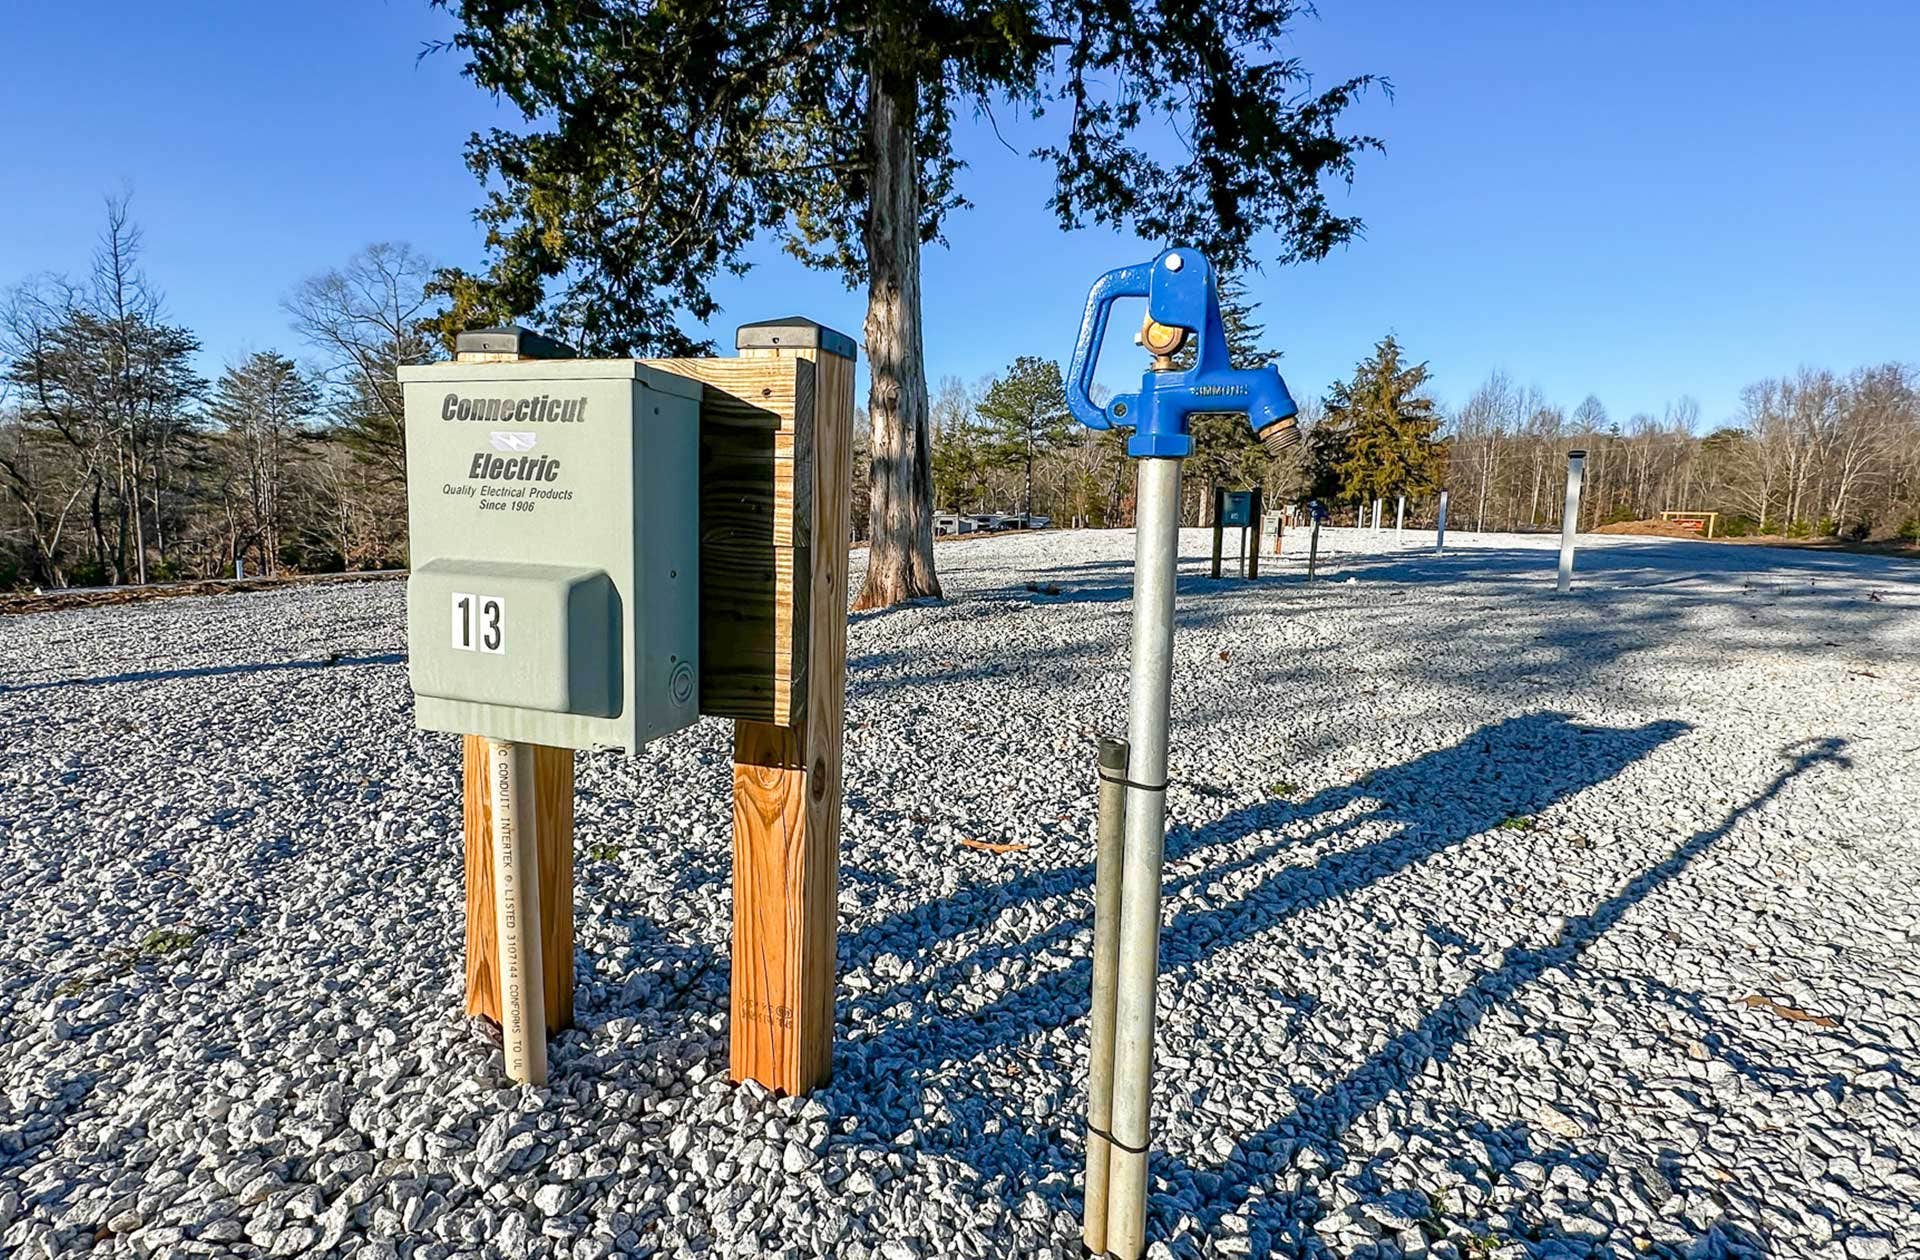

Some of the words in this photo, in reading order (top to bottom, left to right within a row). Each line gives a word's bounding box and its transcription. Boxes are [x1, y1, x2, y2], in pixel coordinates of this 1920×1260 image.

[441, 393, 587, 423] Connecticut
[469, 453, 560, 482] Electric
[442, 483, 477, 498] Quality
[480, 485, 526, 498] Electrical
[529, 487, 573, 501] Products
[479, 499, 507, 511] Since
[511, 501, 536, 513] 1906
[458, 597, 501, 651] 13
[499, 762, 510, 810] CONDUIT
[501, 818, 513, 868] INTERTEK
[504, 889, 516, 929] LISTED
[509, 984, 521, 1034] CONFORMS
[512, 1040, 523, 1053] TO
[513, 1059, 523, 1071] UL
